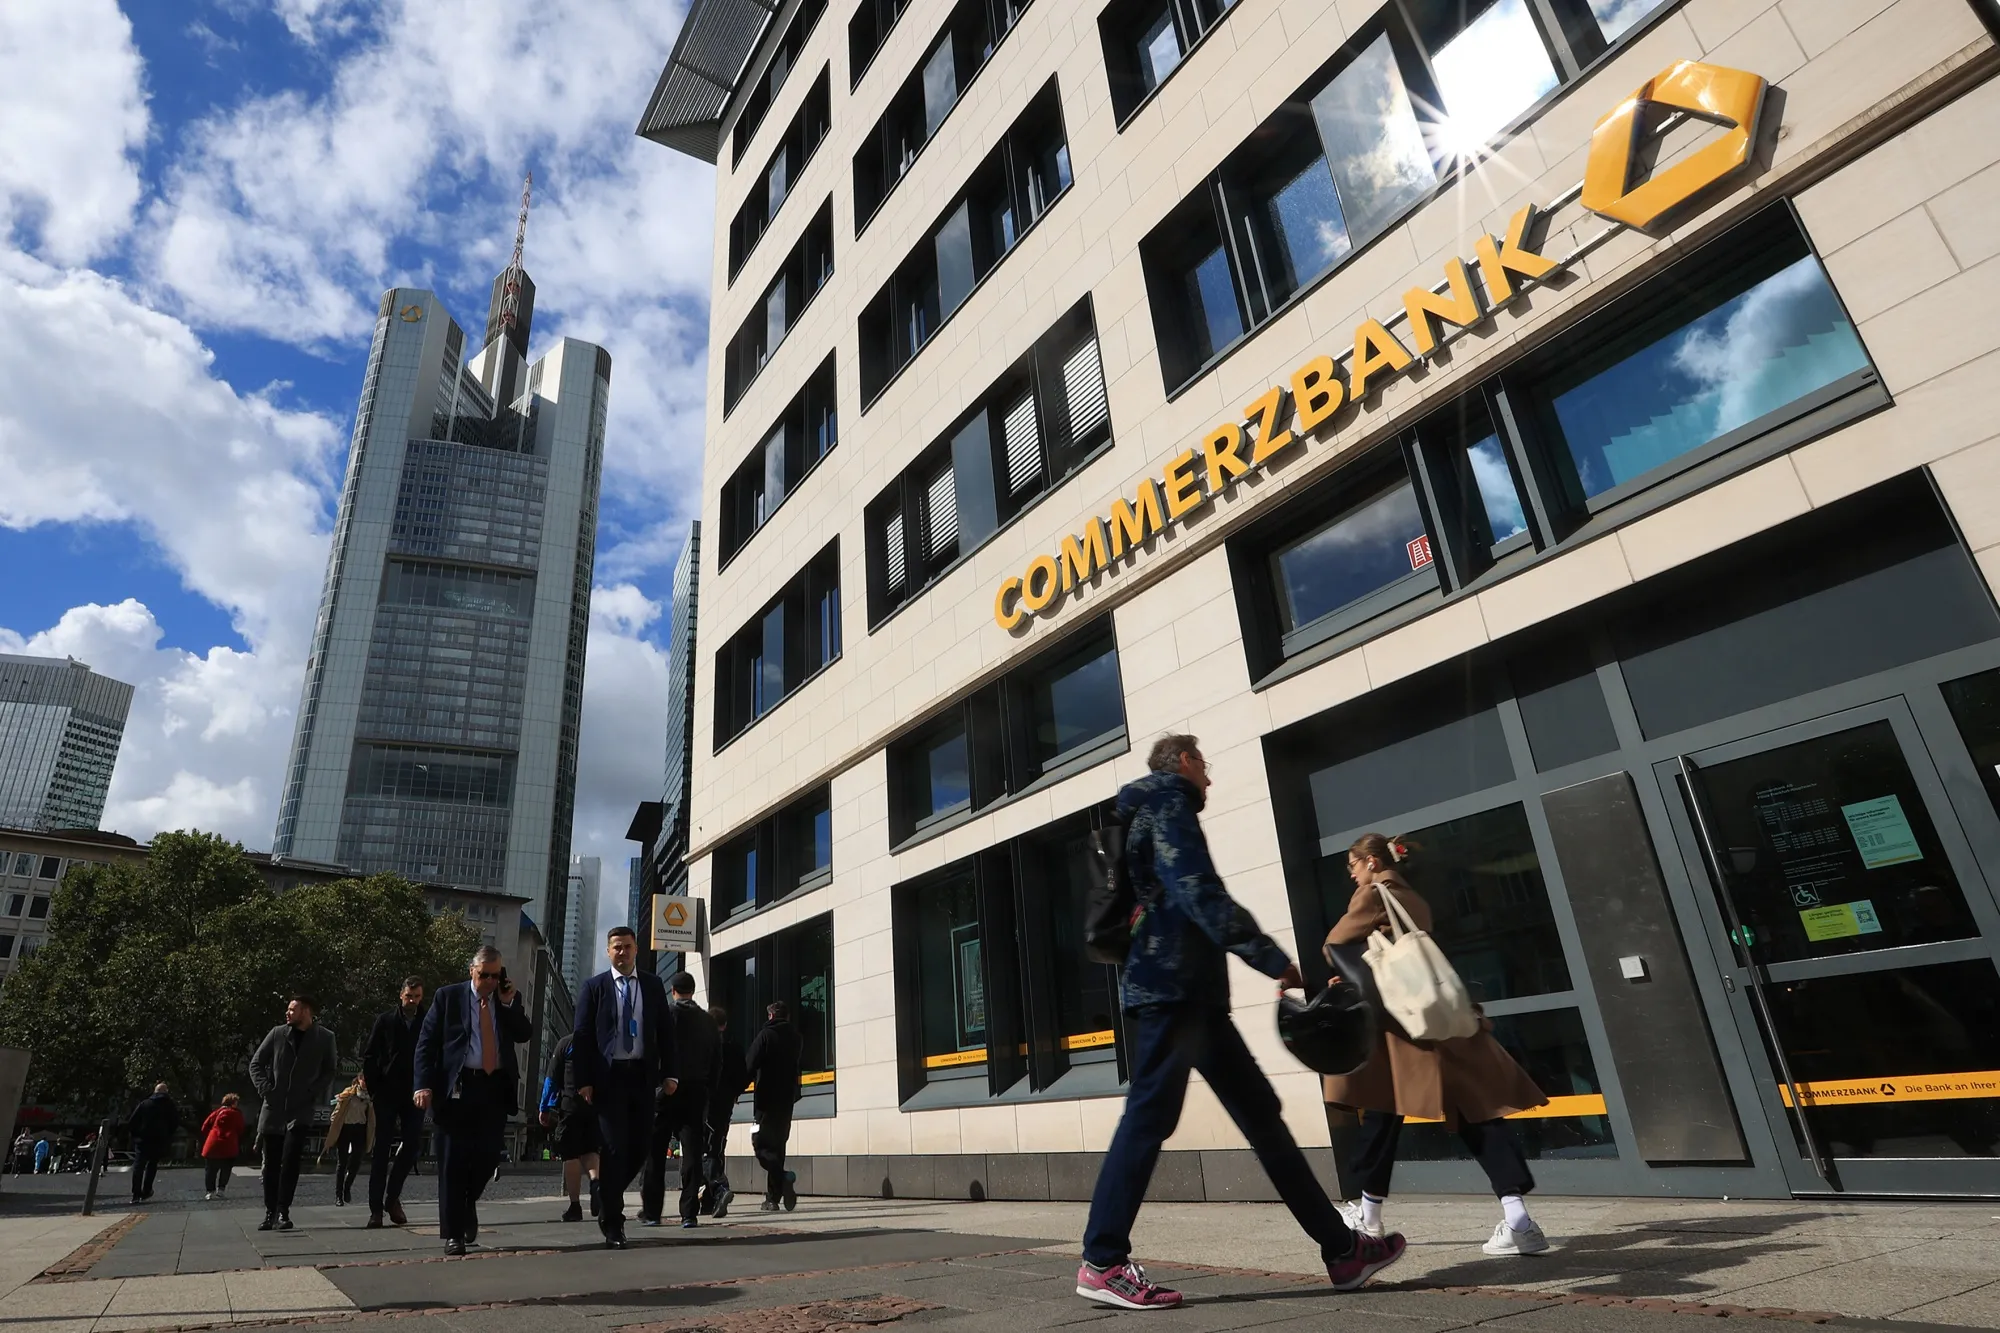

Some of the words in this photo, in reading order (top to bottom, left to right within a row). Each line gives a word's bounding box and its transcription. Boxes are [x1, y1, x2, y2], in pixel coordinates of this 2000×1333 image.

[994, 203, 1559, 631] COMMERZBANK
[1798, 1087, 1878, 1099] COMMERZBANK
[1905, 1084, 1922, 1093] Die
[1925, 1082, 1952, 1092] Bank
[1970, 1081, 1997, 1090] Ihrer
